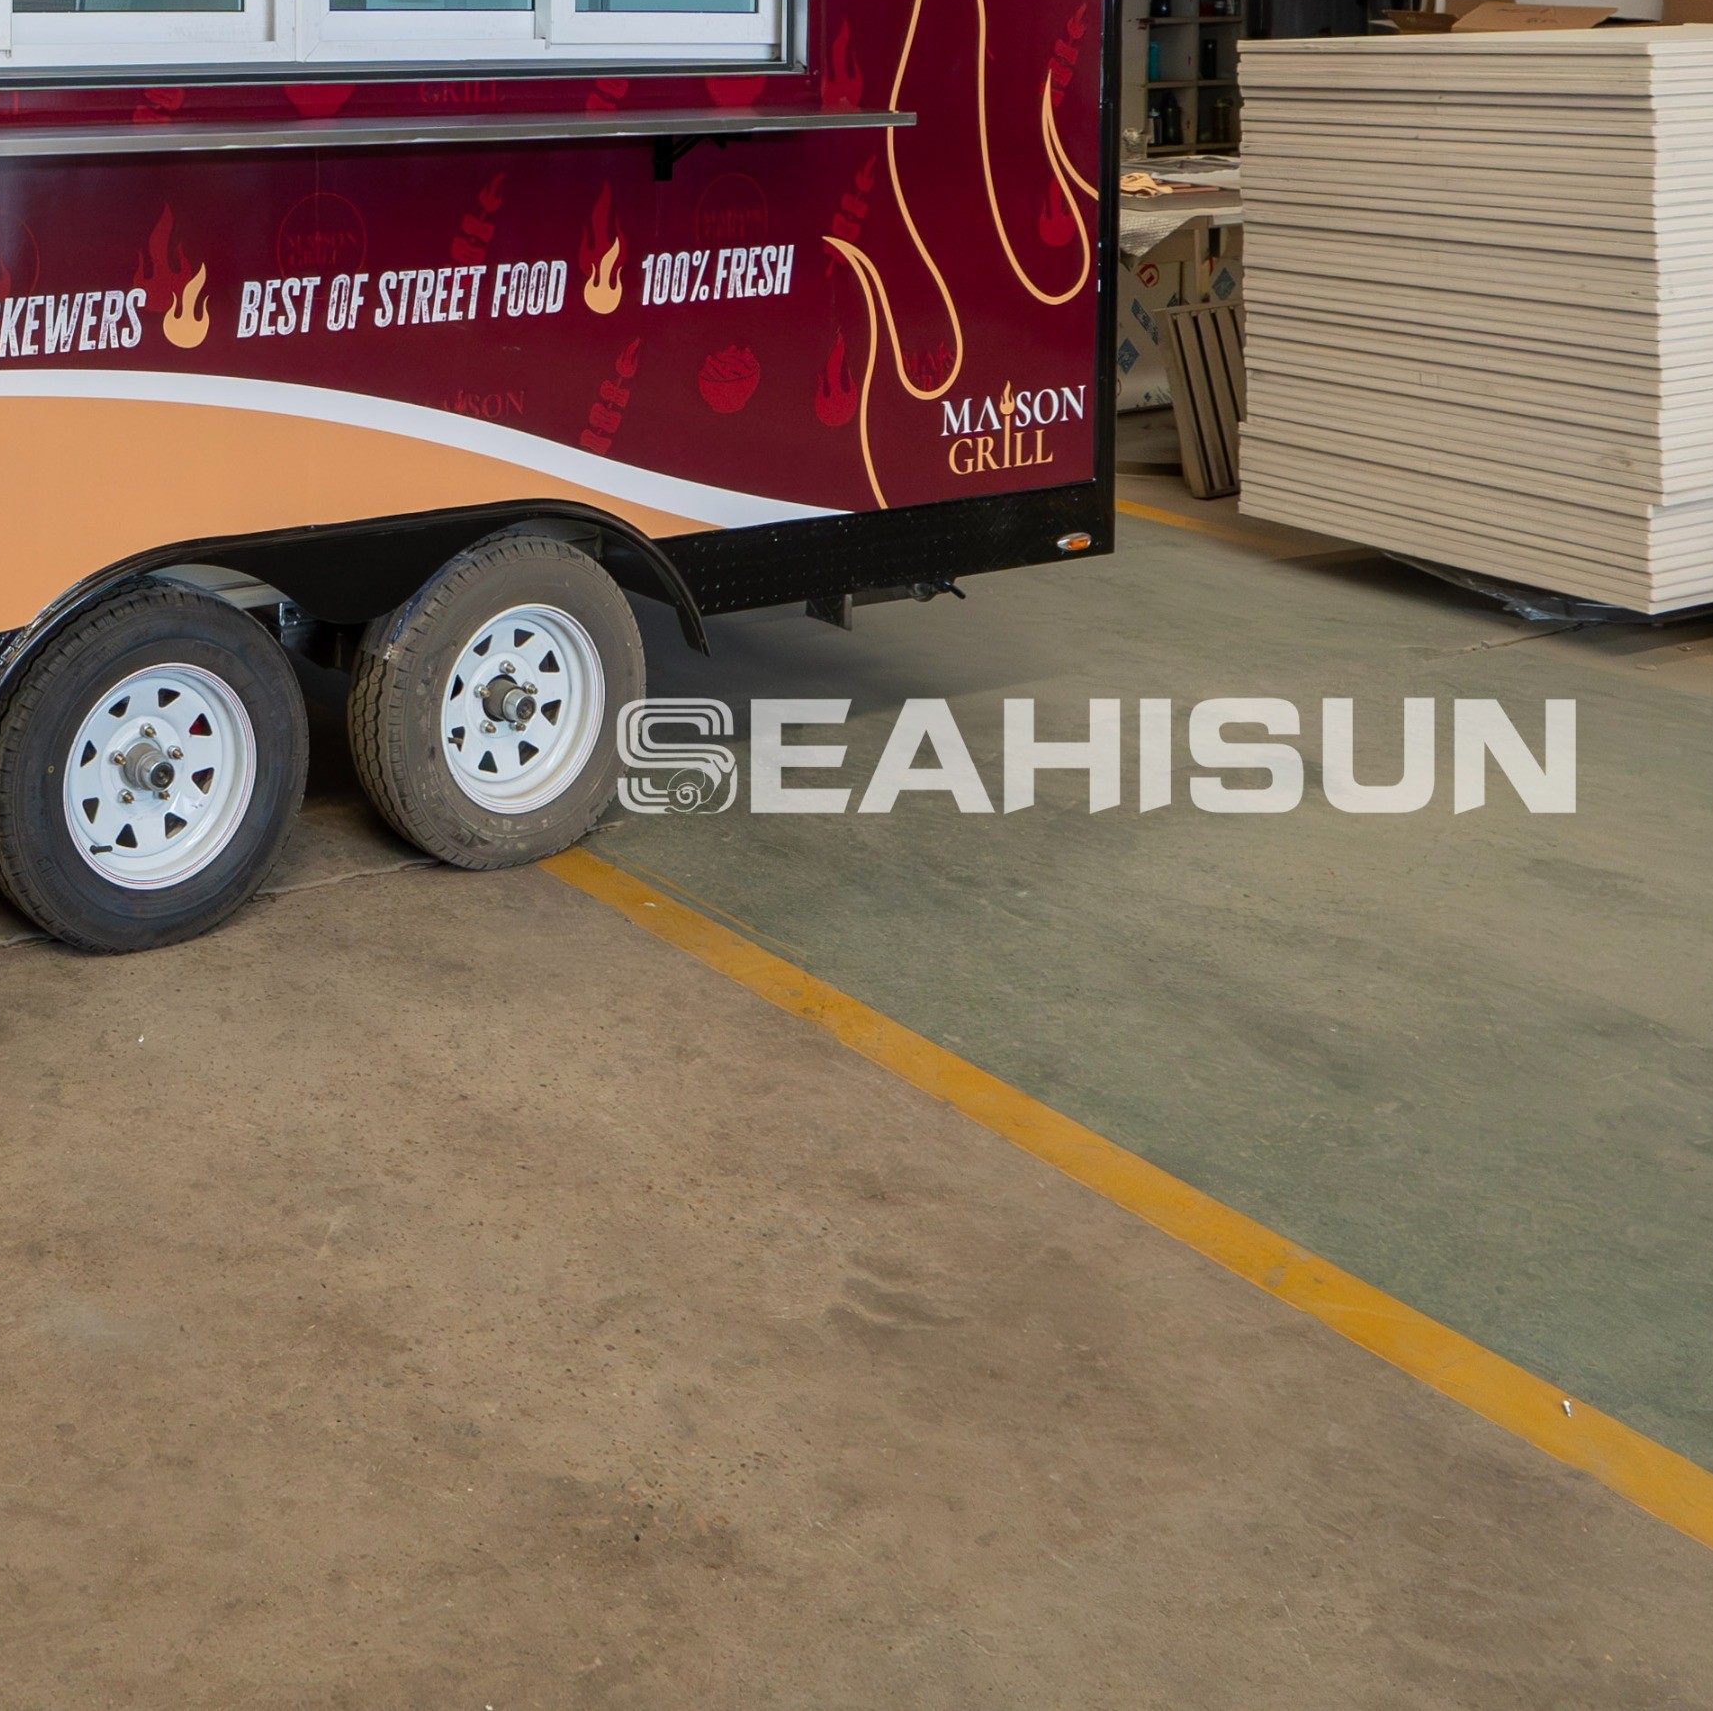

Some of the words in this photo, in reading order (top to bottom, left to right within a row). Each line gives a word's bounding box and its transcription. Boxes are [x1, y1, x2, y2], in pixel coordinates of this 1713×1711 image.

[237, 273, 319, 339] BEST
[326, 269, 368, 332] OF
[375, 265, 487, 327] STREET
[490, 259, 567, 318] FOOD
[642, 249, 710, 306] 100%
[715, 244, 795, 301] FRESH
[940, 381, 1087, 436] MAISON
[949, 426, 1053, 475] GRILL
